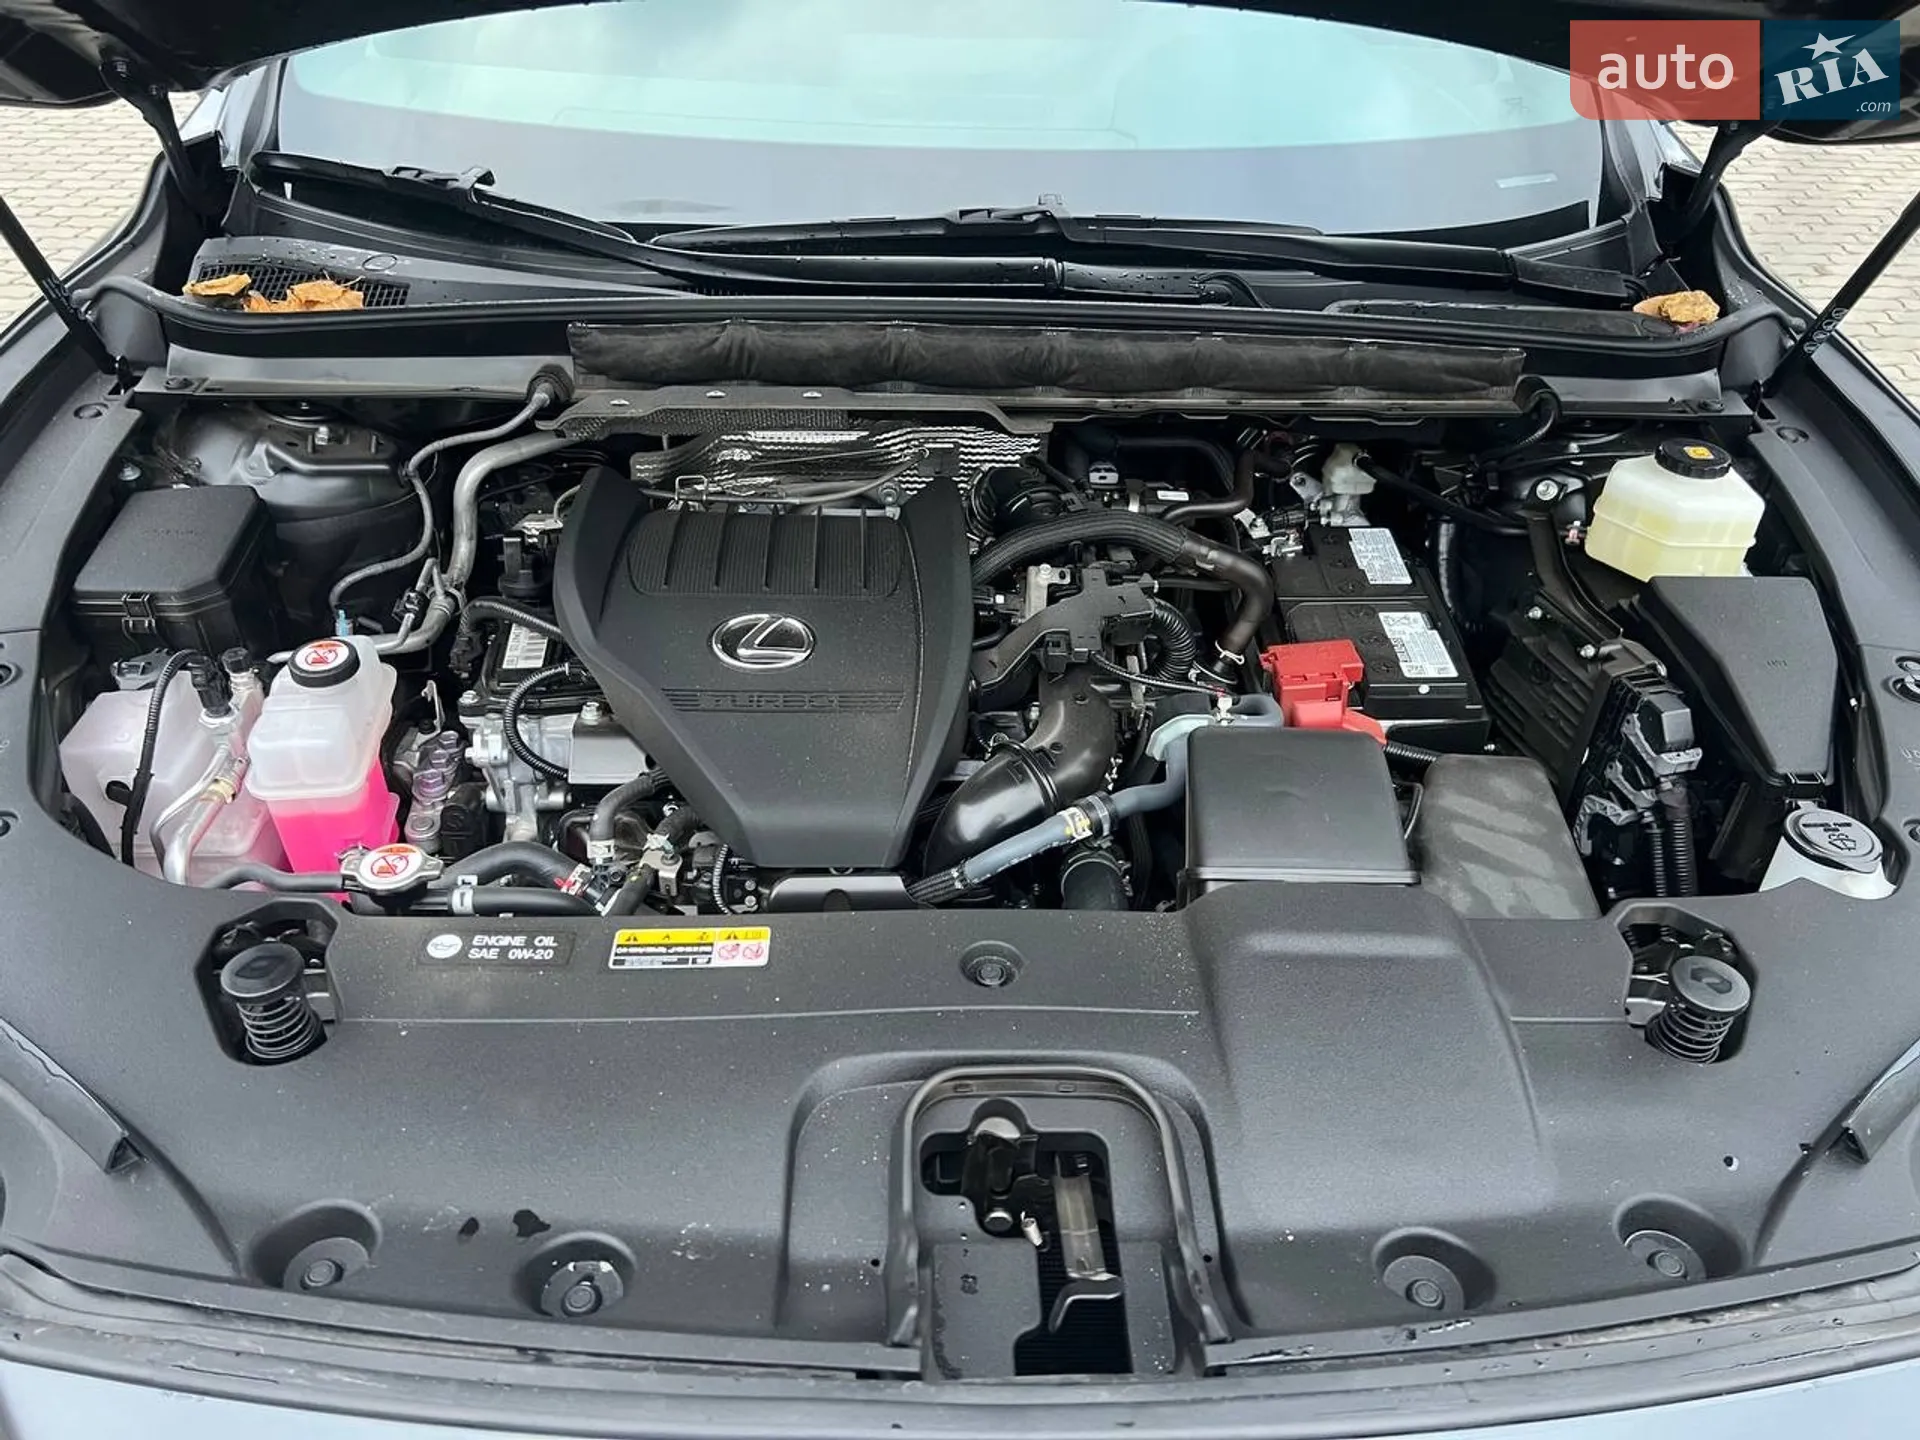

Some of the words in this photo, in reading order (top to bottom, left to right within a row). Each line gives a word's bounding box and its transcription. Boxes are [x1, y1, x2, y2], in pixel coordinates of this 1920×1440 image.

[702, 694, 838, 708] TURBO
[472, 935, 527, 947] ENGINE
[534, 936, 559, 947] OIL
[468, 948, 500, 960] SAE
[508, 948, 554, 960] 0W-20
